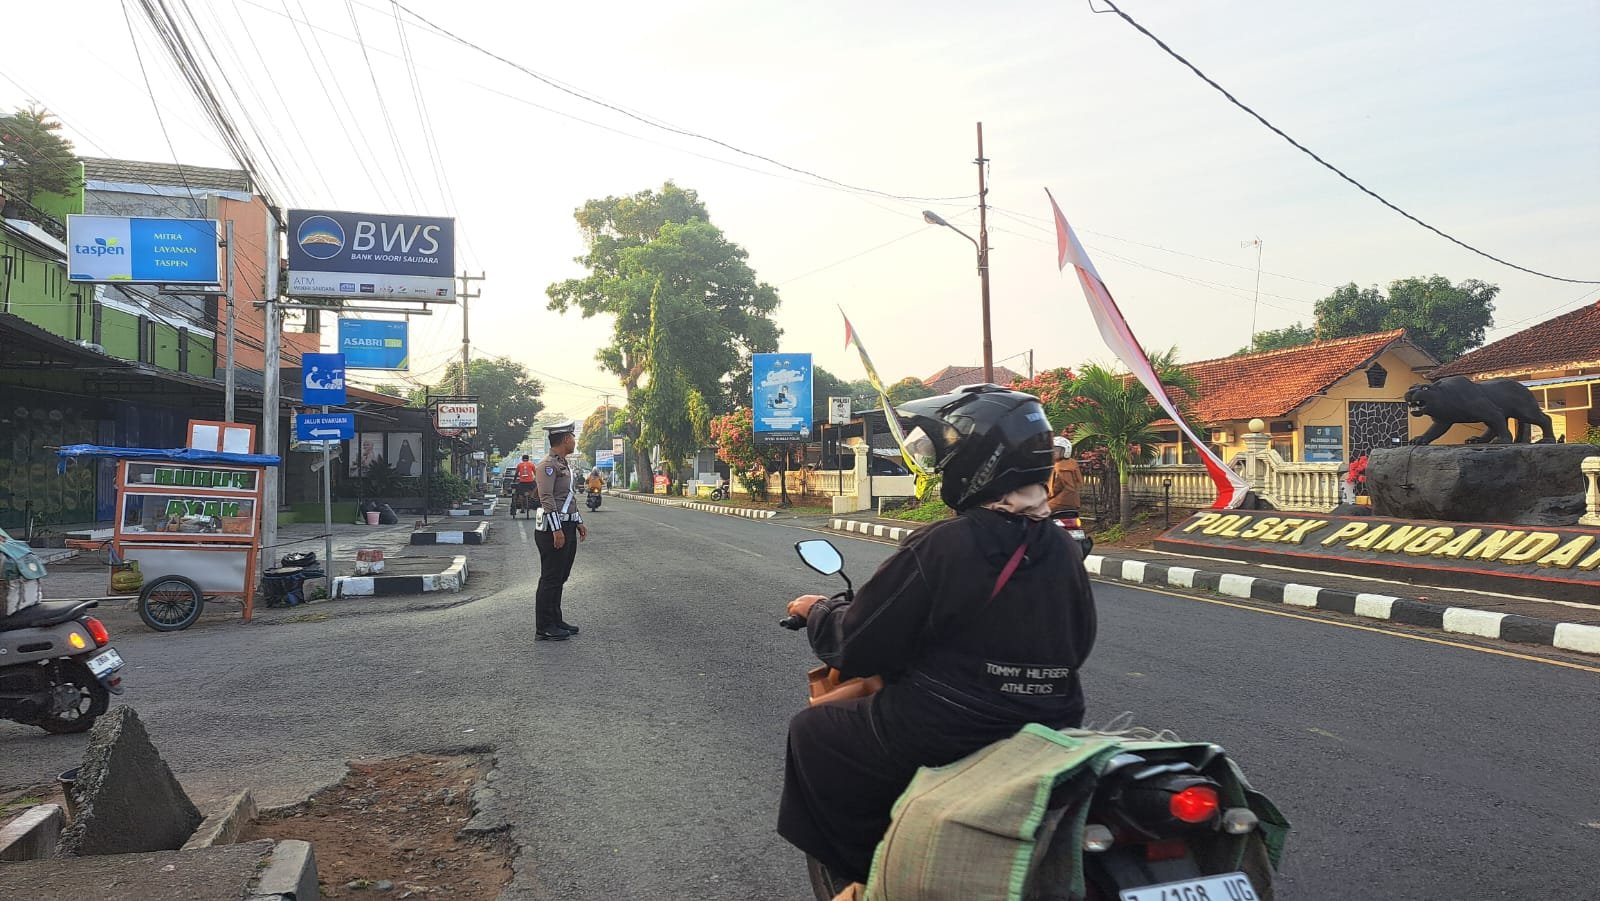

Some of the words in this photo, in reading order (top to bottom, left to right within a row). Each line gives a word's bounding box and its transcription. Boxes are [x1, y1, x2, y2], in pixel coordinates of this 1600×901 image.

[154, 233, 182, 241] MITRA
[352, 221, 441, 255] BWS
[75, 244, 125, 257] taspen
[154, 246, 197, 254] LAYANAN
[155, 259, 189, 267] TASPEN
[351, 253, 373, 261] BANK
[374, 254, 401, 262] WOORI
[403, 255, 439, 265] SAUDARA
[344, 337, 383, 347] ASABRI
[440, 405, 475, 414] Canon
[1183, 513, 1328, 545] POLSEK
[985, 662, 1022, 678] TOMMY
[1026, 667, 1070, 680] HILFIGER
[1000, 682, 1055, 695] ATHLETICS
